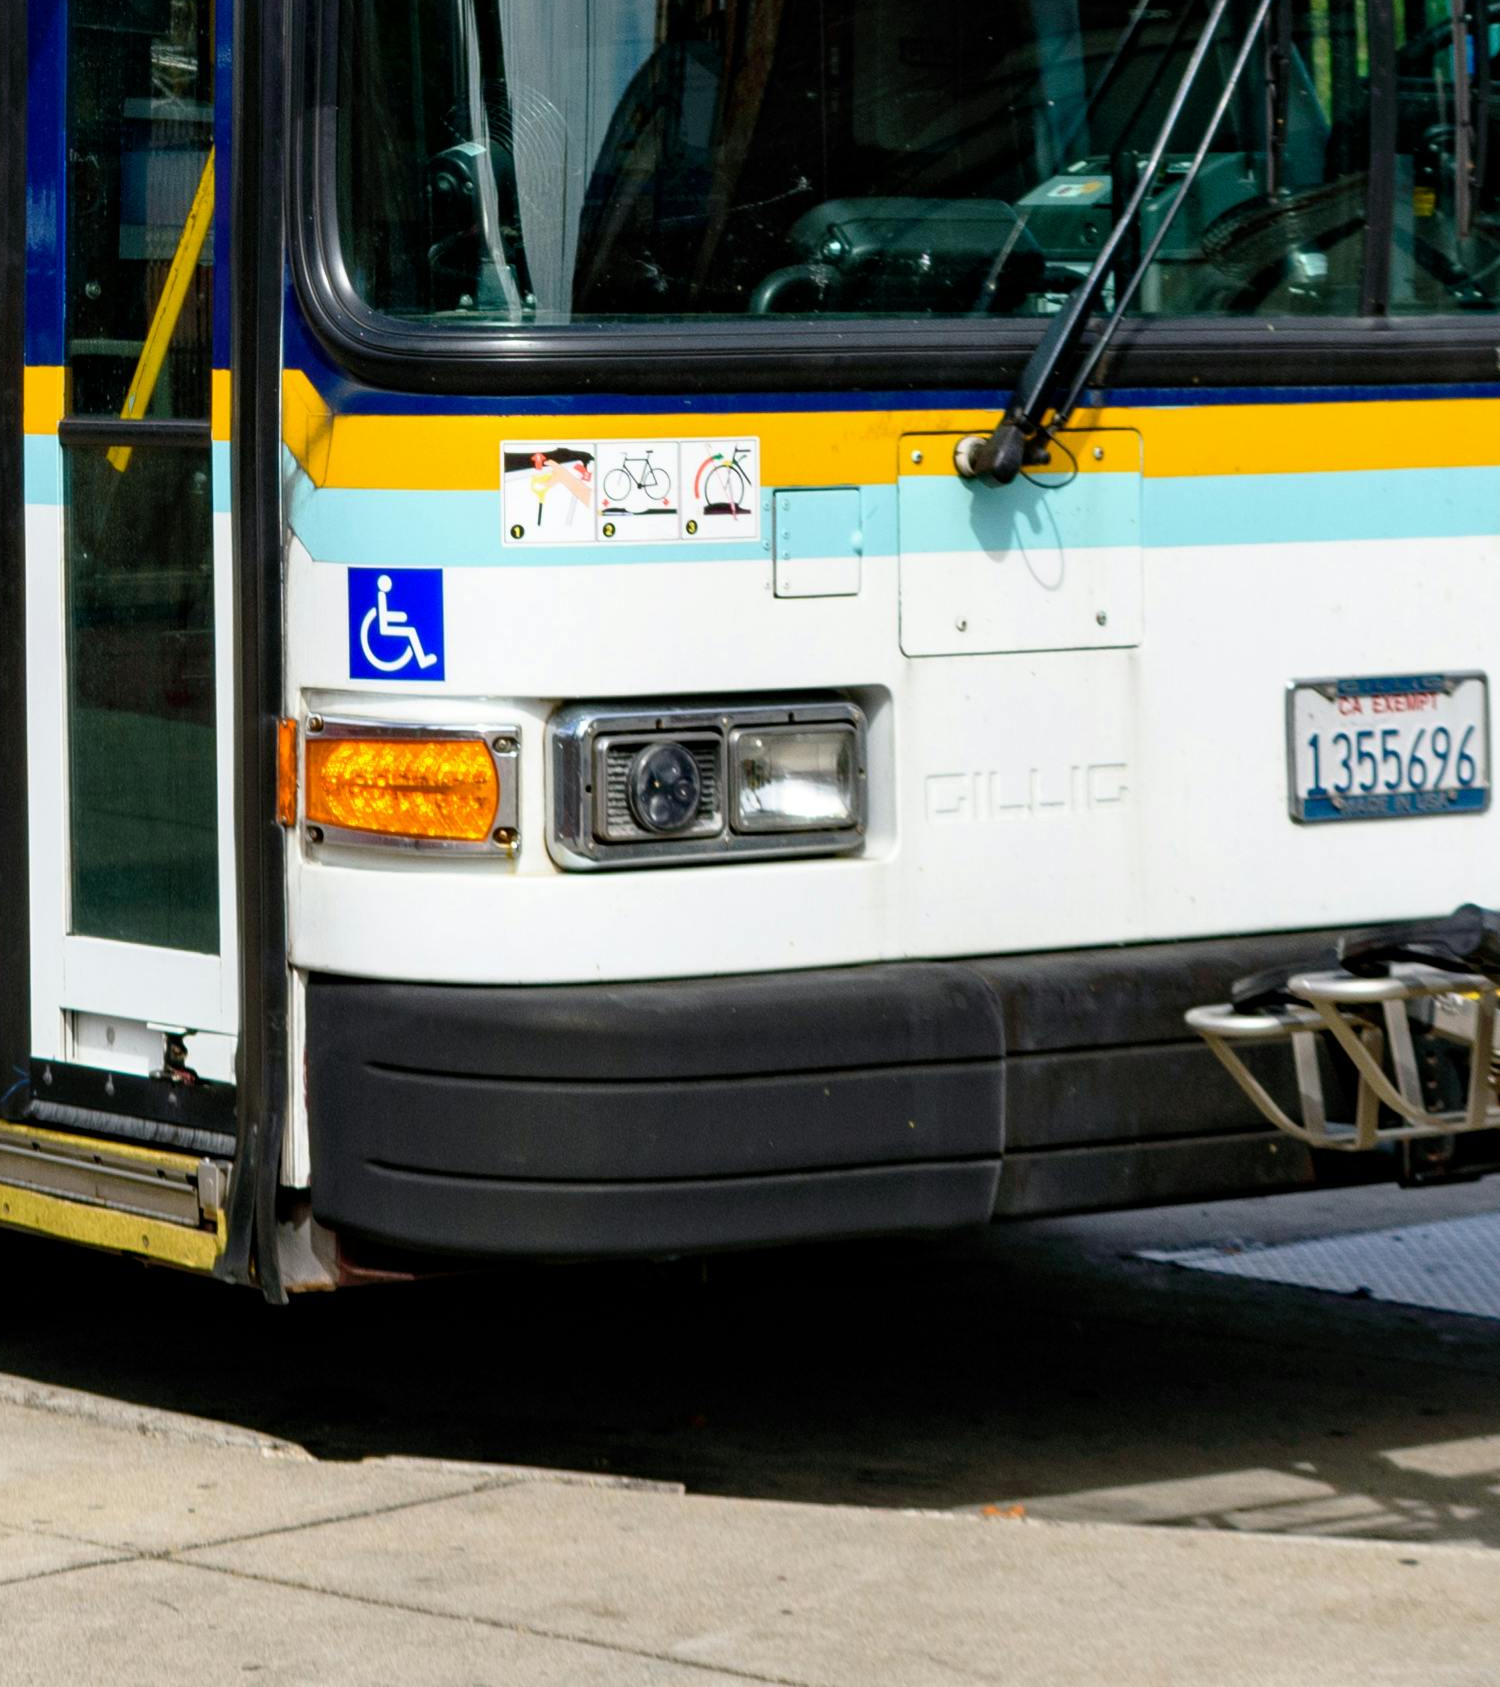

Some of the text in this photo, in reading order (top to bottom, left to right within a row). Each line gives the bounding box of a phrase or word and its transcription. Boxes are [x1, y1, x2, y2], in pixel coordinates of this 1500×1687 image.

[1338, 693, 1440, 716] CA EXEMPT
[923, 760, 1129, 826] GILLIG
[1307, 724, 1476, 798] 1355696
